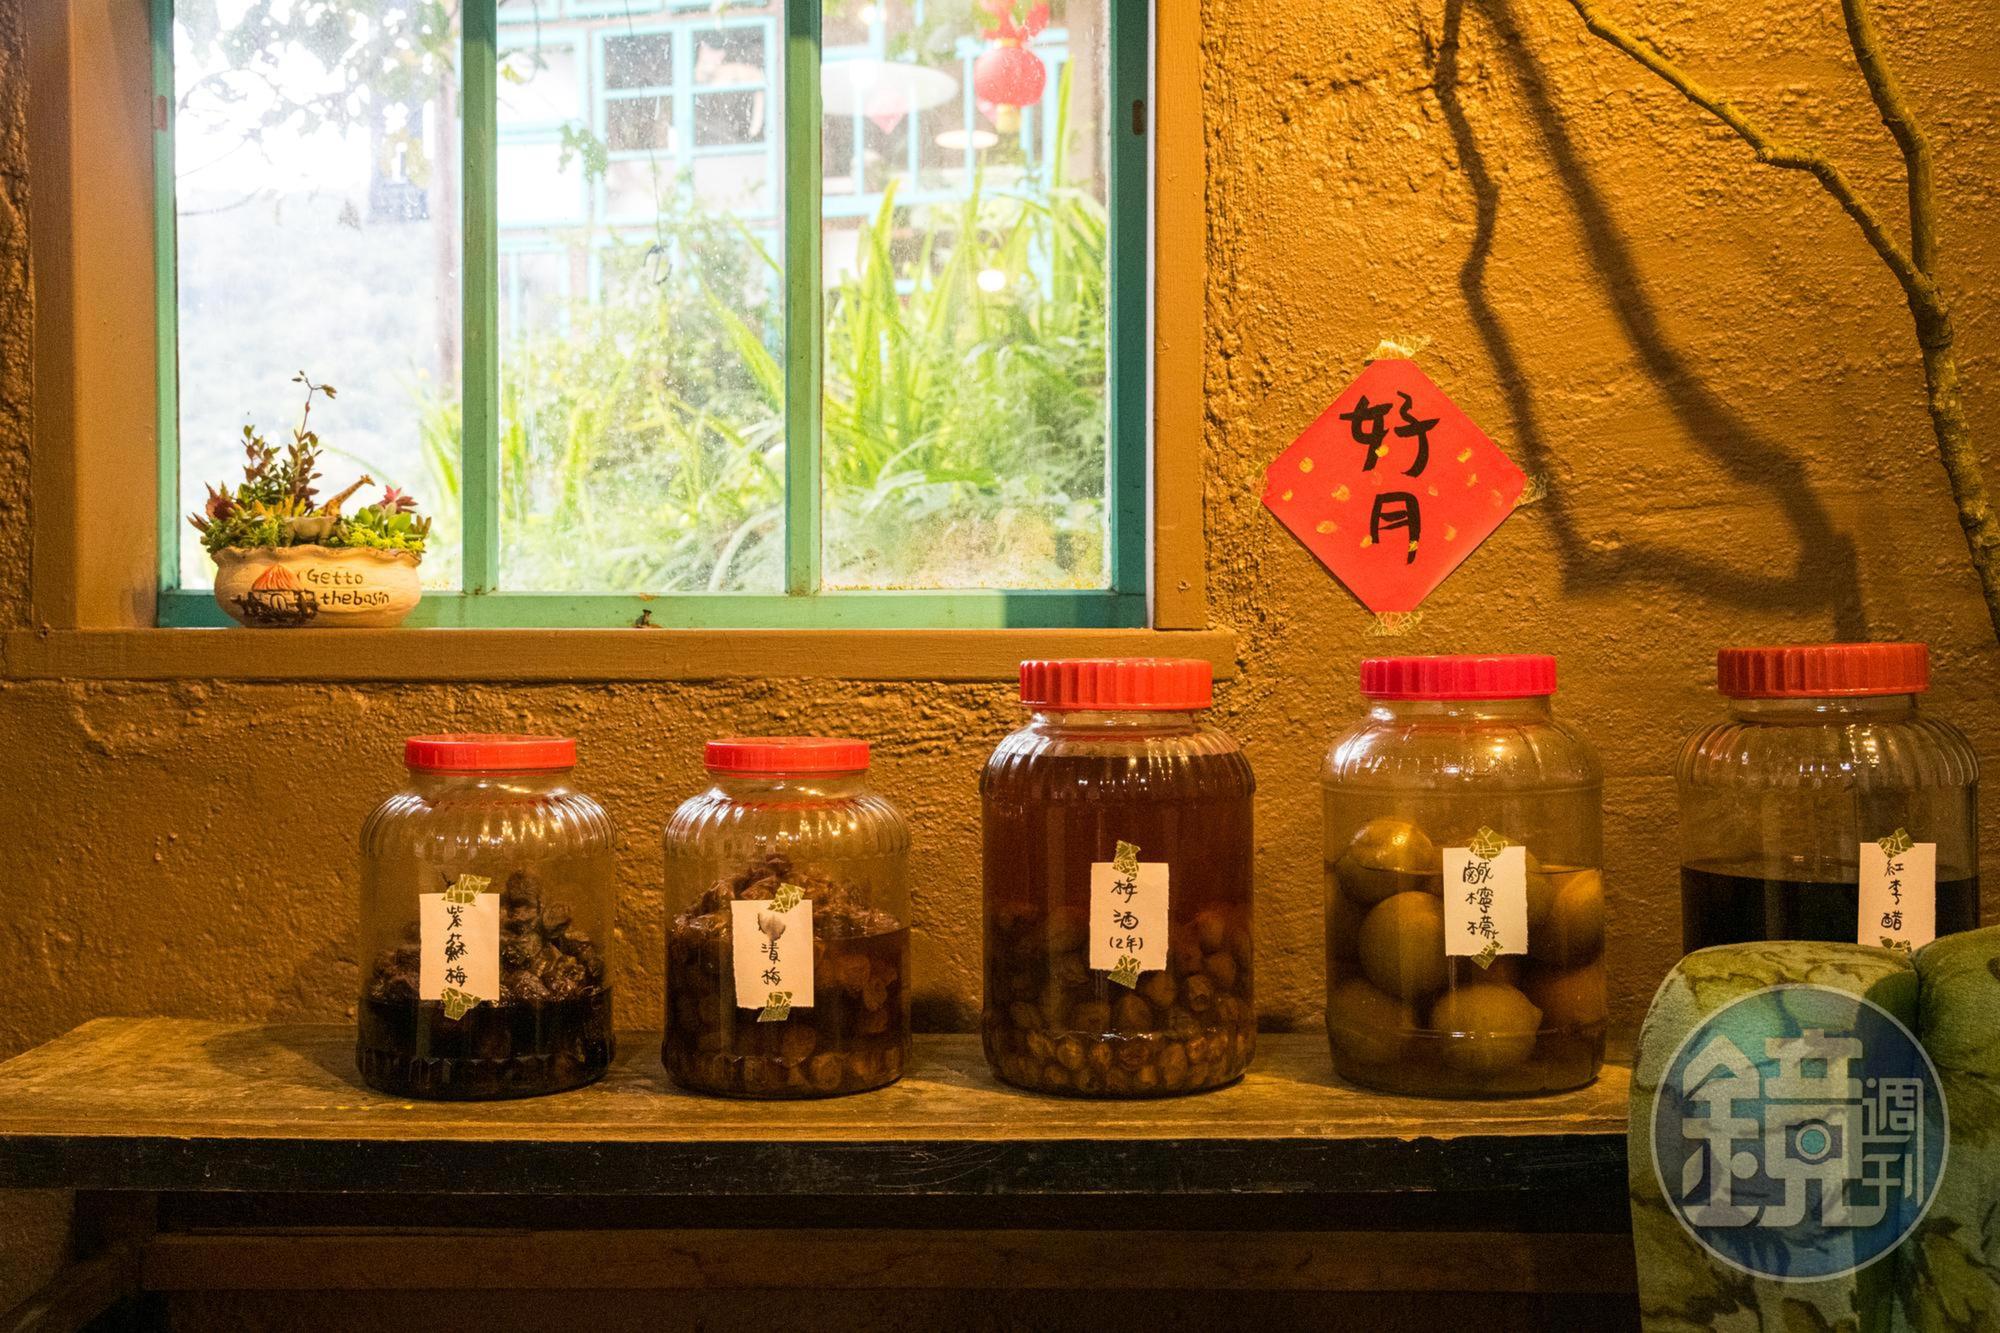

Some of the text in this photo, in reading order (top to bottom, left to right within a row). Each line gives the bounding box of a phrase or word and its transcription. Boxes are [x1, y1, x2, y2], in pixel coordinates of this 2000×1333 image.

[1339, 390, 1440, 565] 好月
[1880, 859, 1904, 931] 紅李醋
